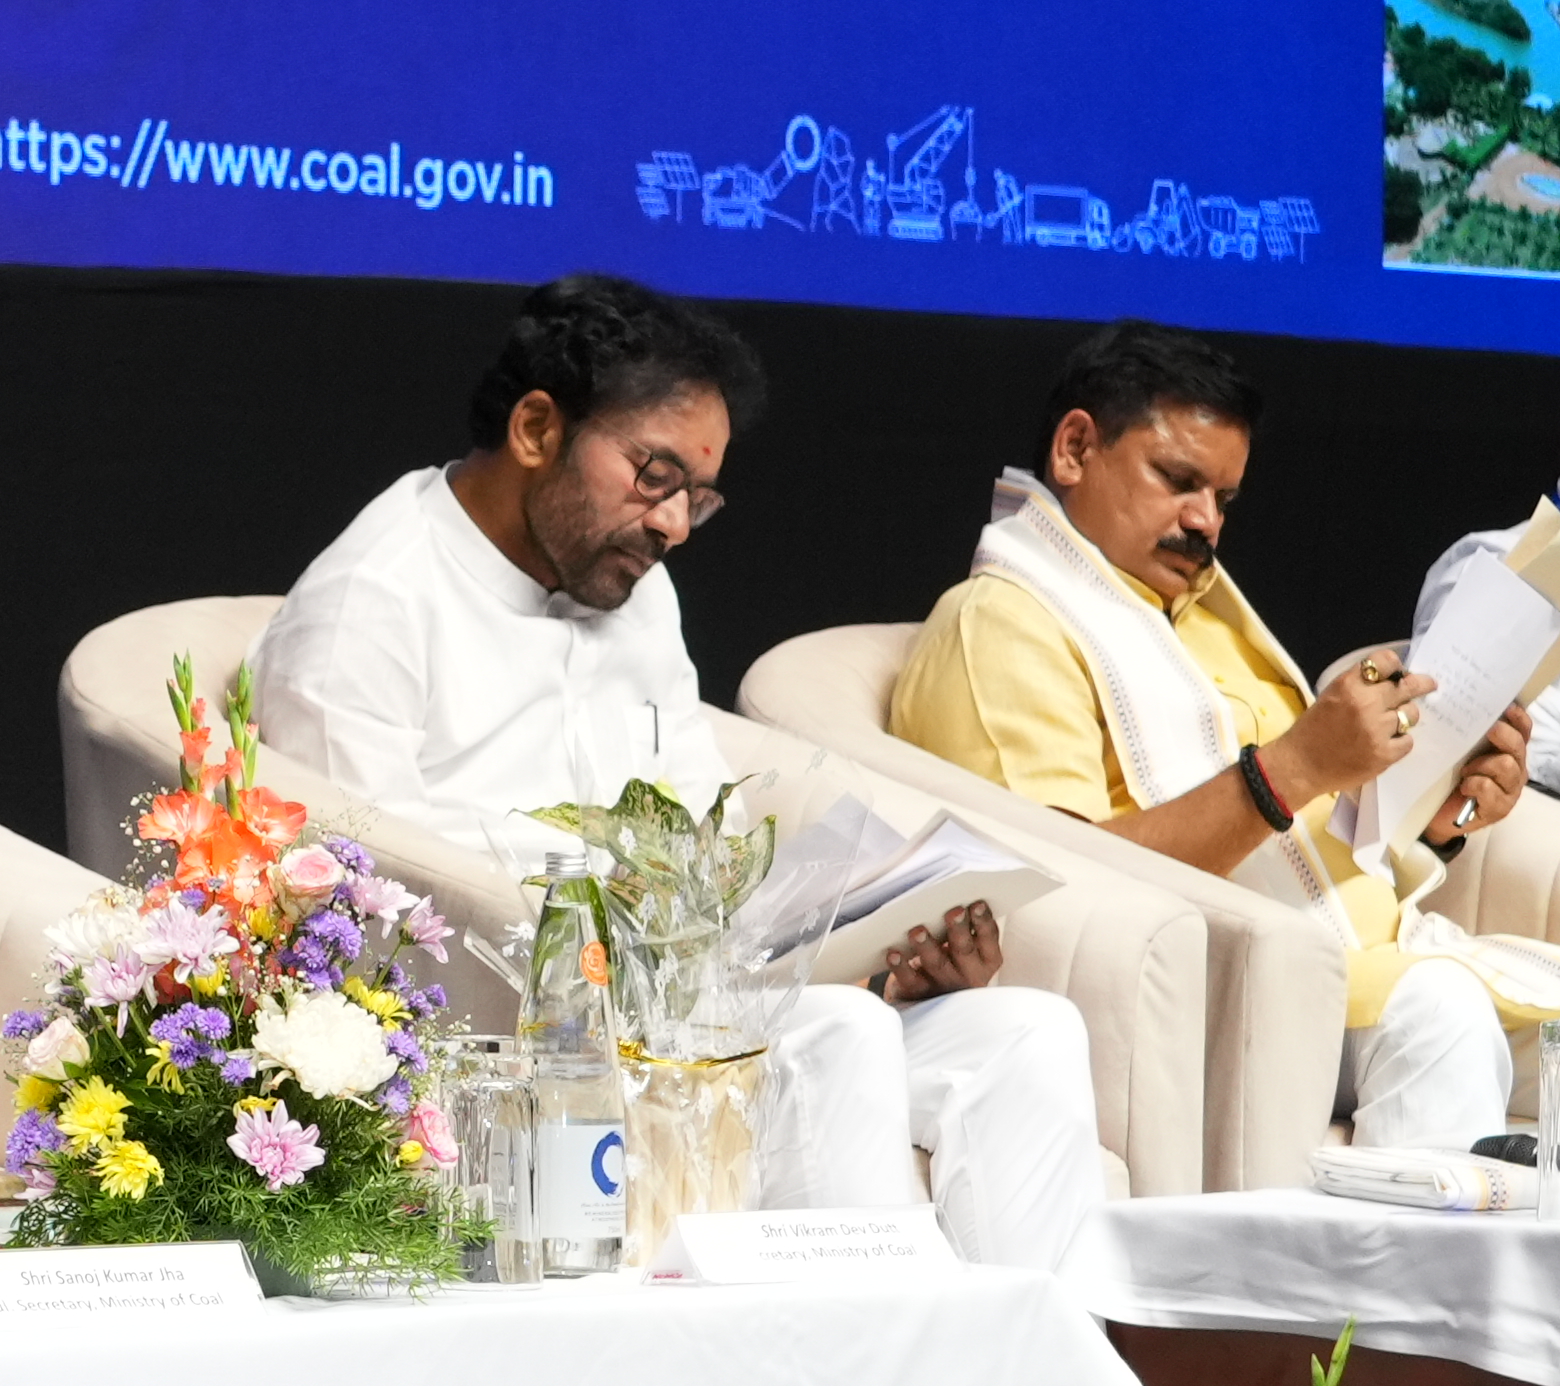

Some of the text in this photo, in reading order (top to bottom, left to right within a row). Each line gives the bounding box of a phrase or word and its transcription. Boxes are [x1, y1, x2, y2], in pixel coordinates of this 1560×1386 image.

[761, 1222, 900, 1238] Shri Vikram Dev Dutt
[758, 1243, 917, 1262] cretary, Ministry of Coal
[20, 1266, 185, 1287] Shri Sanoj Kumar Jha
[17, 1298, 97, 1313] Secretary,
[100, 1295, 167, 1310] Ministry
[170, 1294, 185, 1307] of
[189, 1292, 224, 1307] Coal
